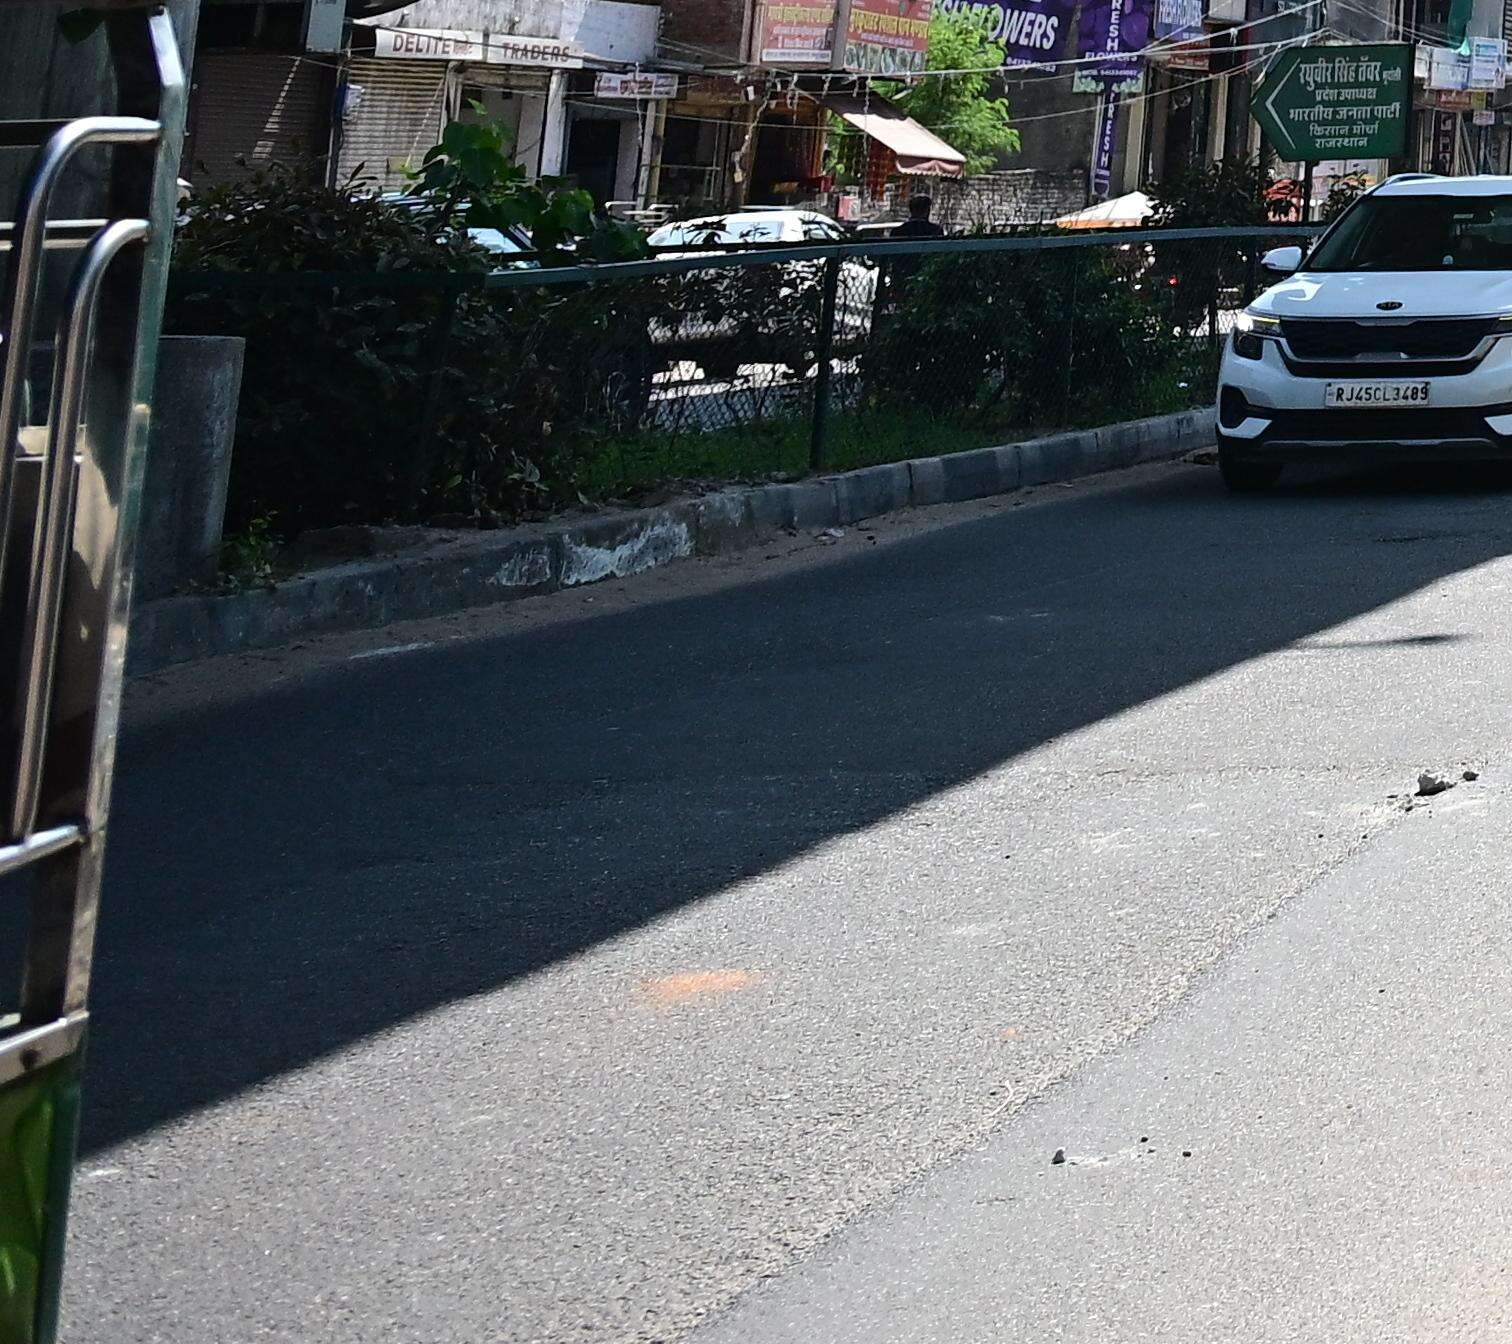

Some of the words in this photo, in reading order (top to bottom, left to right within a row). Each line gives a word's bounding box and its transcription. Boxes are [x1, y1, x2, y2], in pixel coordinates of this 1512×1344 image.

[392, 31, 451, 56] DELITE
[502, 42, 570, 63] TRADERS
[1299, 57, 1334, 91] रघुवीर
[1335, 57, 1357, 83] सिंह
[1315, 86, 1339, 101] प्रदेश
[1339, 87, 1377, 100] उपाध्यक्ष
[1288, 105, 1334, 122] भारतीय
[1336, 106, 1371, 120] जनता
[1374, 102, 1401, 119] पार्टी
[1309, 123, 1349, 136] किसान
[1353, 121, 1379, 135] मोर्चा
[1314, 137, 1368, 148] राजस्थान
[1334, 384, 1429, 404] RJ45CL3489
